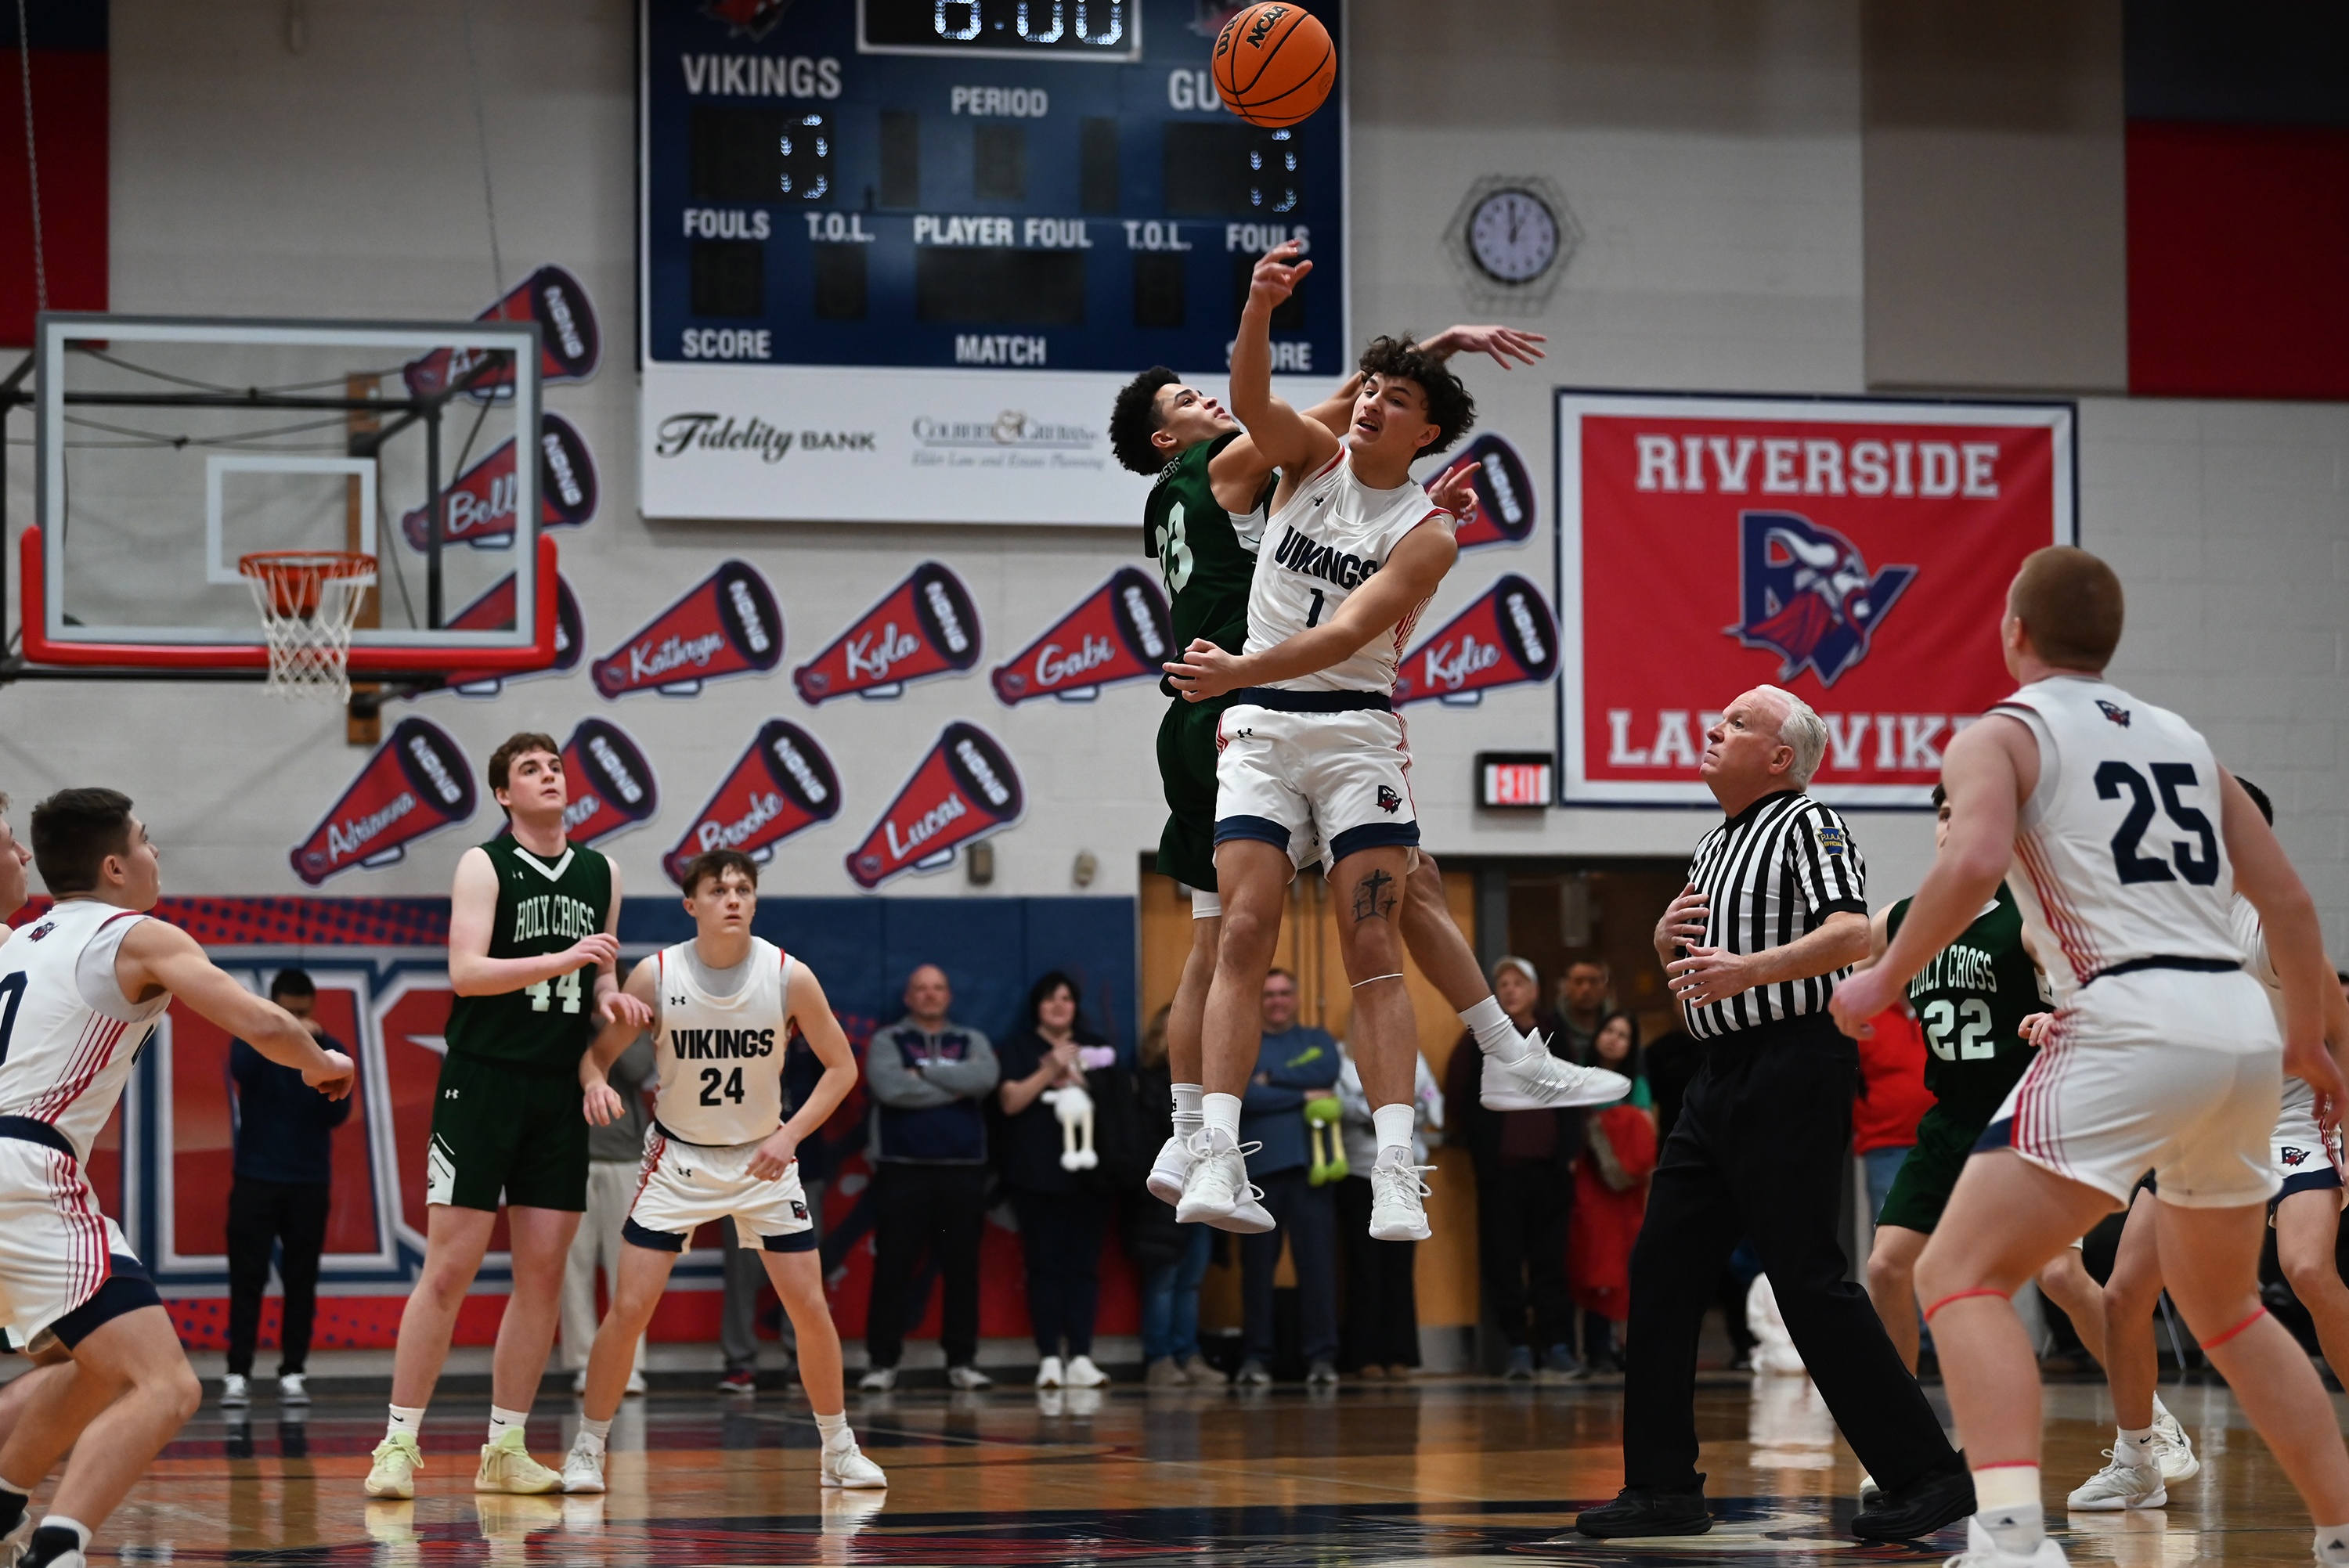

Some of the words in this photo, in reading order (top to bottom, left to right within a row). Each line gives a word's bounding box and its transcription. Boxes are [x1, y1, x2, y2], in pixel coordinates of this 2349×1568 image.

[1247, 5, 1290, 49] NCAA
[682, 53, 842, 99] VIKINGS
[951, 85, 1048, 117] PERIOD
[683, 208, 771, 240] FOULS
[805, 211, 875, 243] T.O.L.
[914, 215, 1014, 247] PLAYER
[1023, 218, 1094, 248] FOUL
[1123, 220, 1192, 251] T.O.L.
[1226, 223, 1311, 254] FOULS
[681, 327, 772, 359] SCORE
[954, 333, 1046, 365] MATCH
[655, 412, 795, 464] Fidelity
[800, 431, 876, 452] BANK
[1636, 434, 1998, 499] RIVERSIDE
[1275, 525, 1378, 589] VIKINGS
[1306, 588, 1325, 628] 1
[846, 622, 920, 680] Kyla
[1425, 634, 1501, 690] Kylie
[1496, 764, 1542, 804] EXIT
[885, 791, 967, 860] Lucas
[2094, 761, 2219, 886] 25
[514, 895, 550, 943] HOLY
[552, 894, 595, 940] CROSS
[525, 952, 582, 1014] 44
[1948, 944, 1997, 993] CROSS
[671, 1029, 775, 1059] VIKINGS
[1923, 998, 1995, 1061] 22
[700, 1067, 745, 1106] 24
